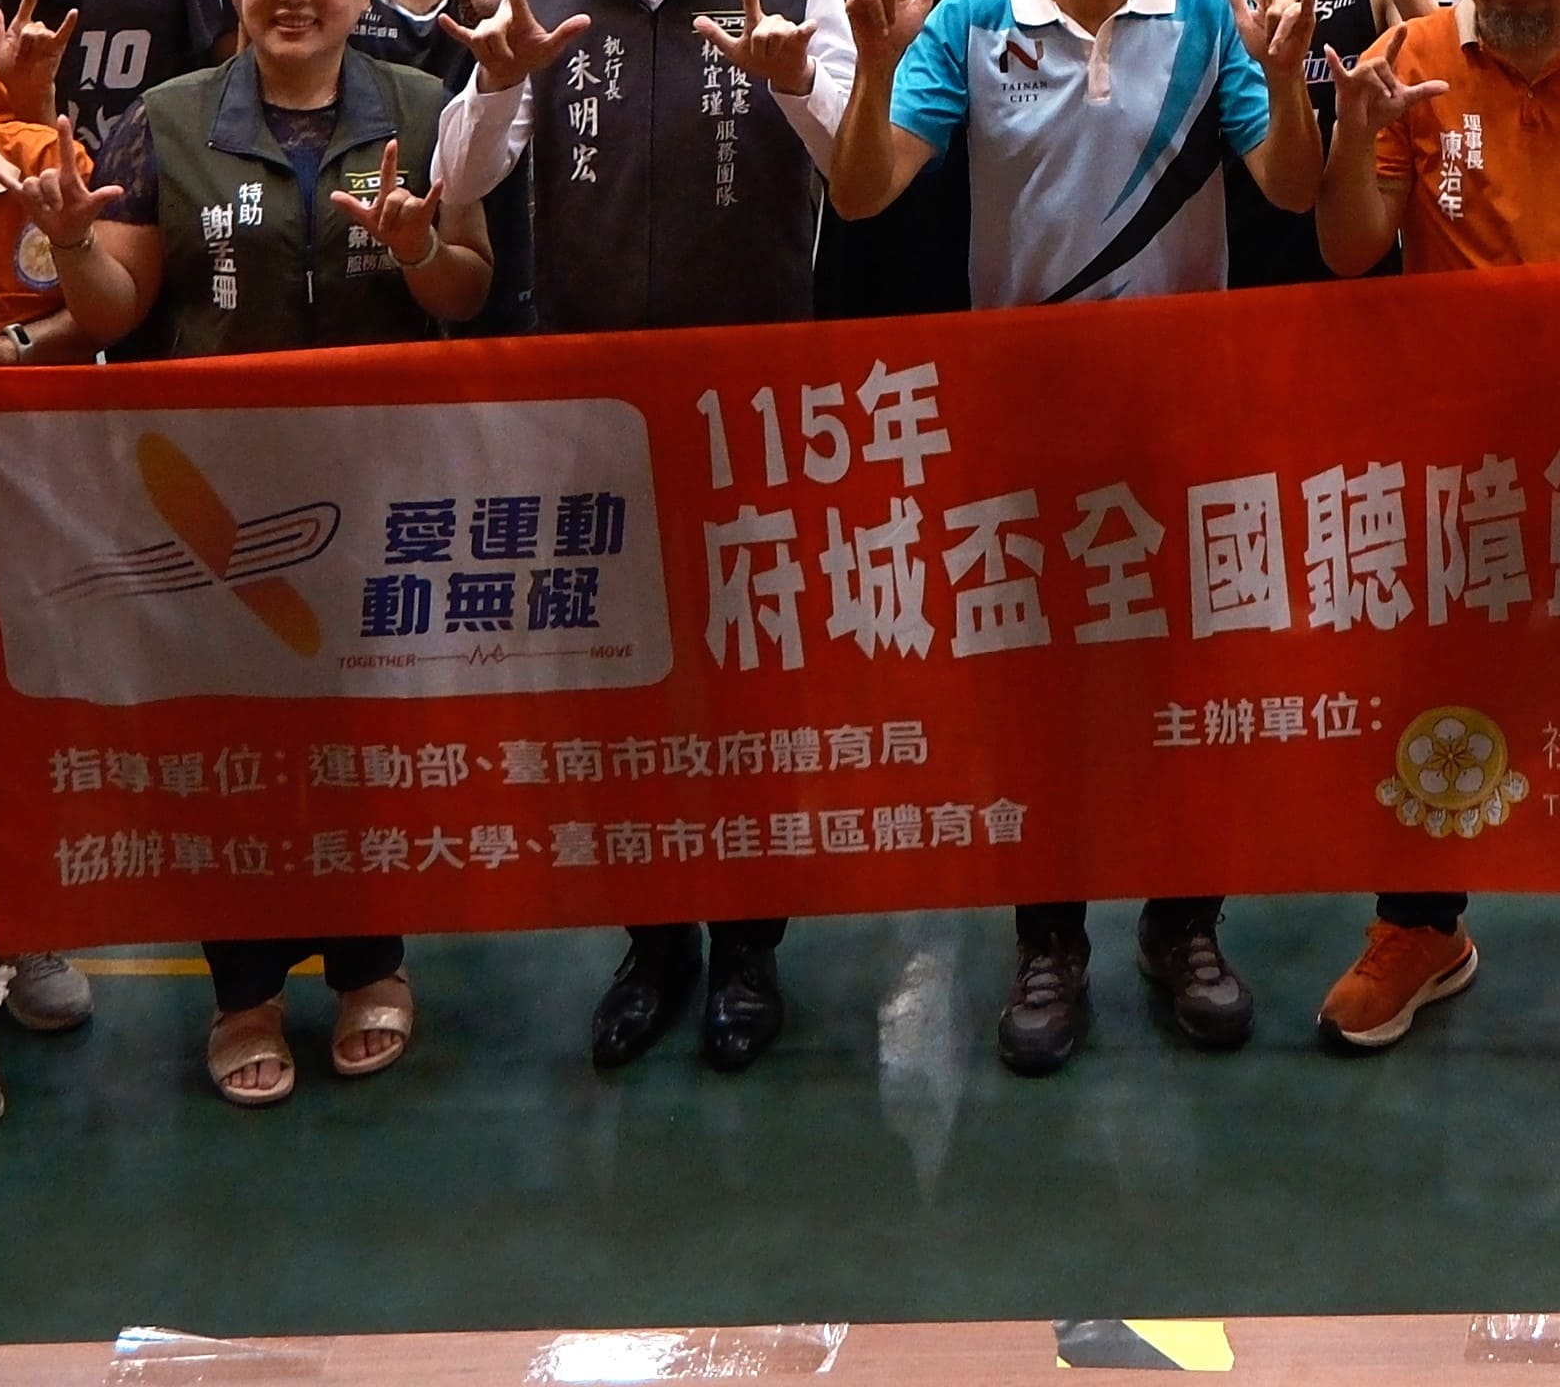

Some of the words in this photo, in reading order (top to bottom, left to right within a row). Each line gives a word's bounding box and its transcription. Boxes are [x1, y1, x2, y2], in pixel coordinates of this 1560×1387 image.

[80, 29, 152, 91] 10
[603, 34, 624, 101] 執行長
[1000, 81, 1048, 92] TAINAN
[568, 50, 602, 183] 朱明宏
[1010, 93, 1040, 104] CITY
[715, 120, 738, 207] 服務團隊
[1462, 113, 1484, 170] 理事長
[238, 182, 264, 227] 特助
[1438, 129, 1464, 222] 陳治年
[696, 357, 953, 490] 115年
[384, 491, 626, 565] 愛運動
[360, 573, 602, 641] 動無礙
[338, 653, 416, 669] TOGETHER
[589, 644, 633, 660] MOVE
